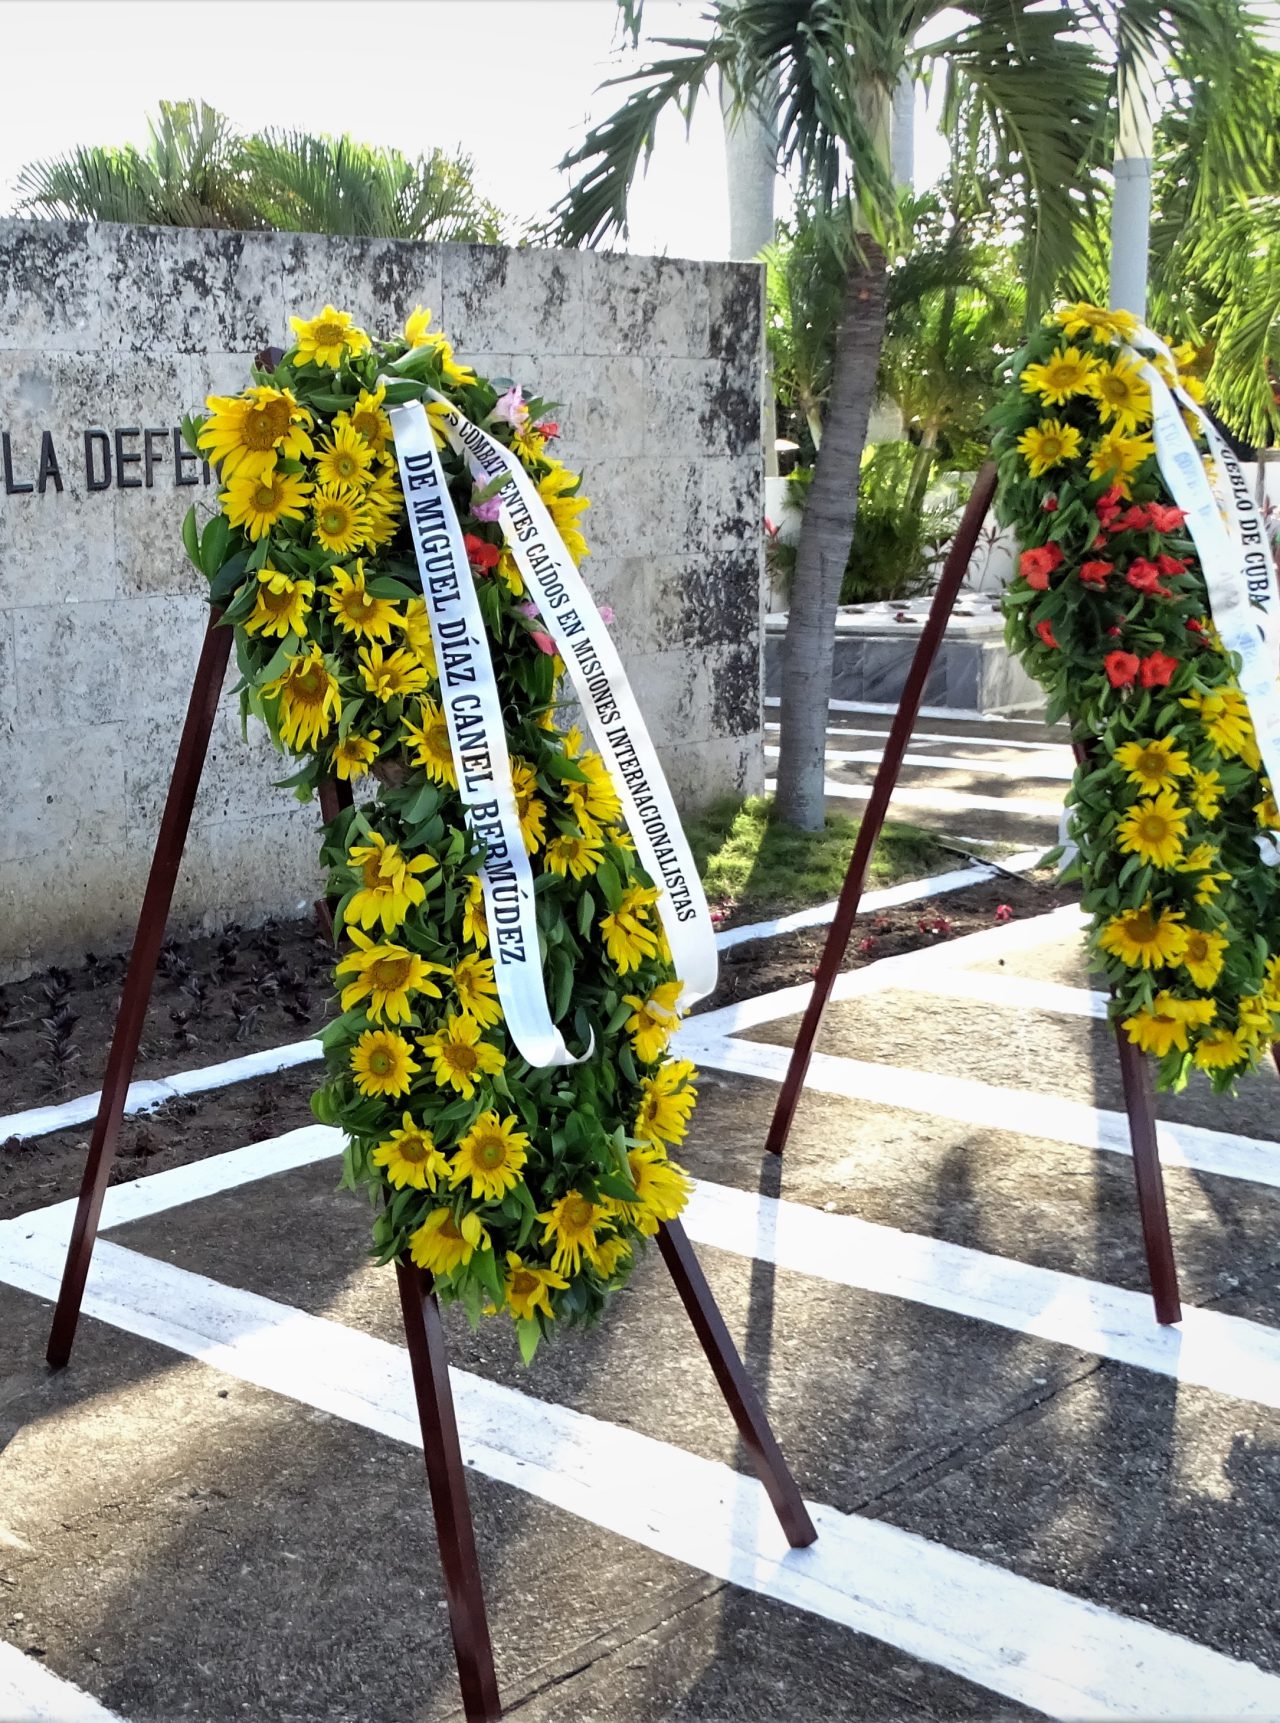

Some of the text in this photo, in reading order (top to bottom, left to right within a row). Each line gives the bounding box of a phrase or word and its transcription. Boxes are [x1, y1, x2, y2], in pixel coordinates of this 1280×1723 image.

[1, 429, 63, 495] LA
[1215, 436, 1253, 512] UEBLO
[1239, 518, 1261, 546] DE
[403, 451, 528, 965] DE MIGUEL DÍAZ CANEL BERMÚDEZ
[459, 422, 696, 922] COMBATENTES CAÍDOS EN MISIONES INTERNACIONALISTAS
